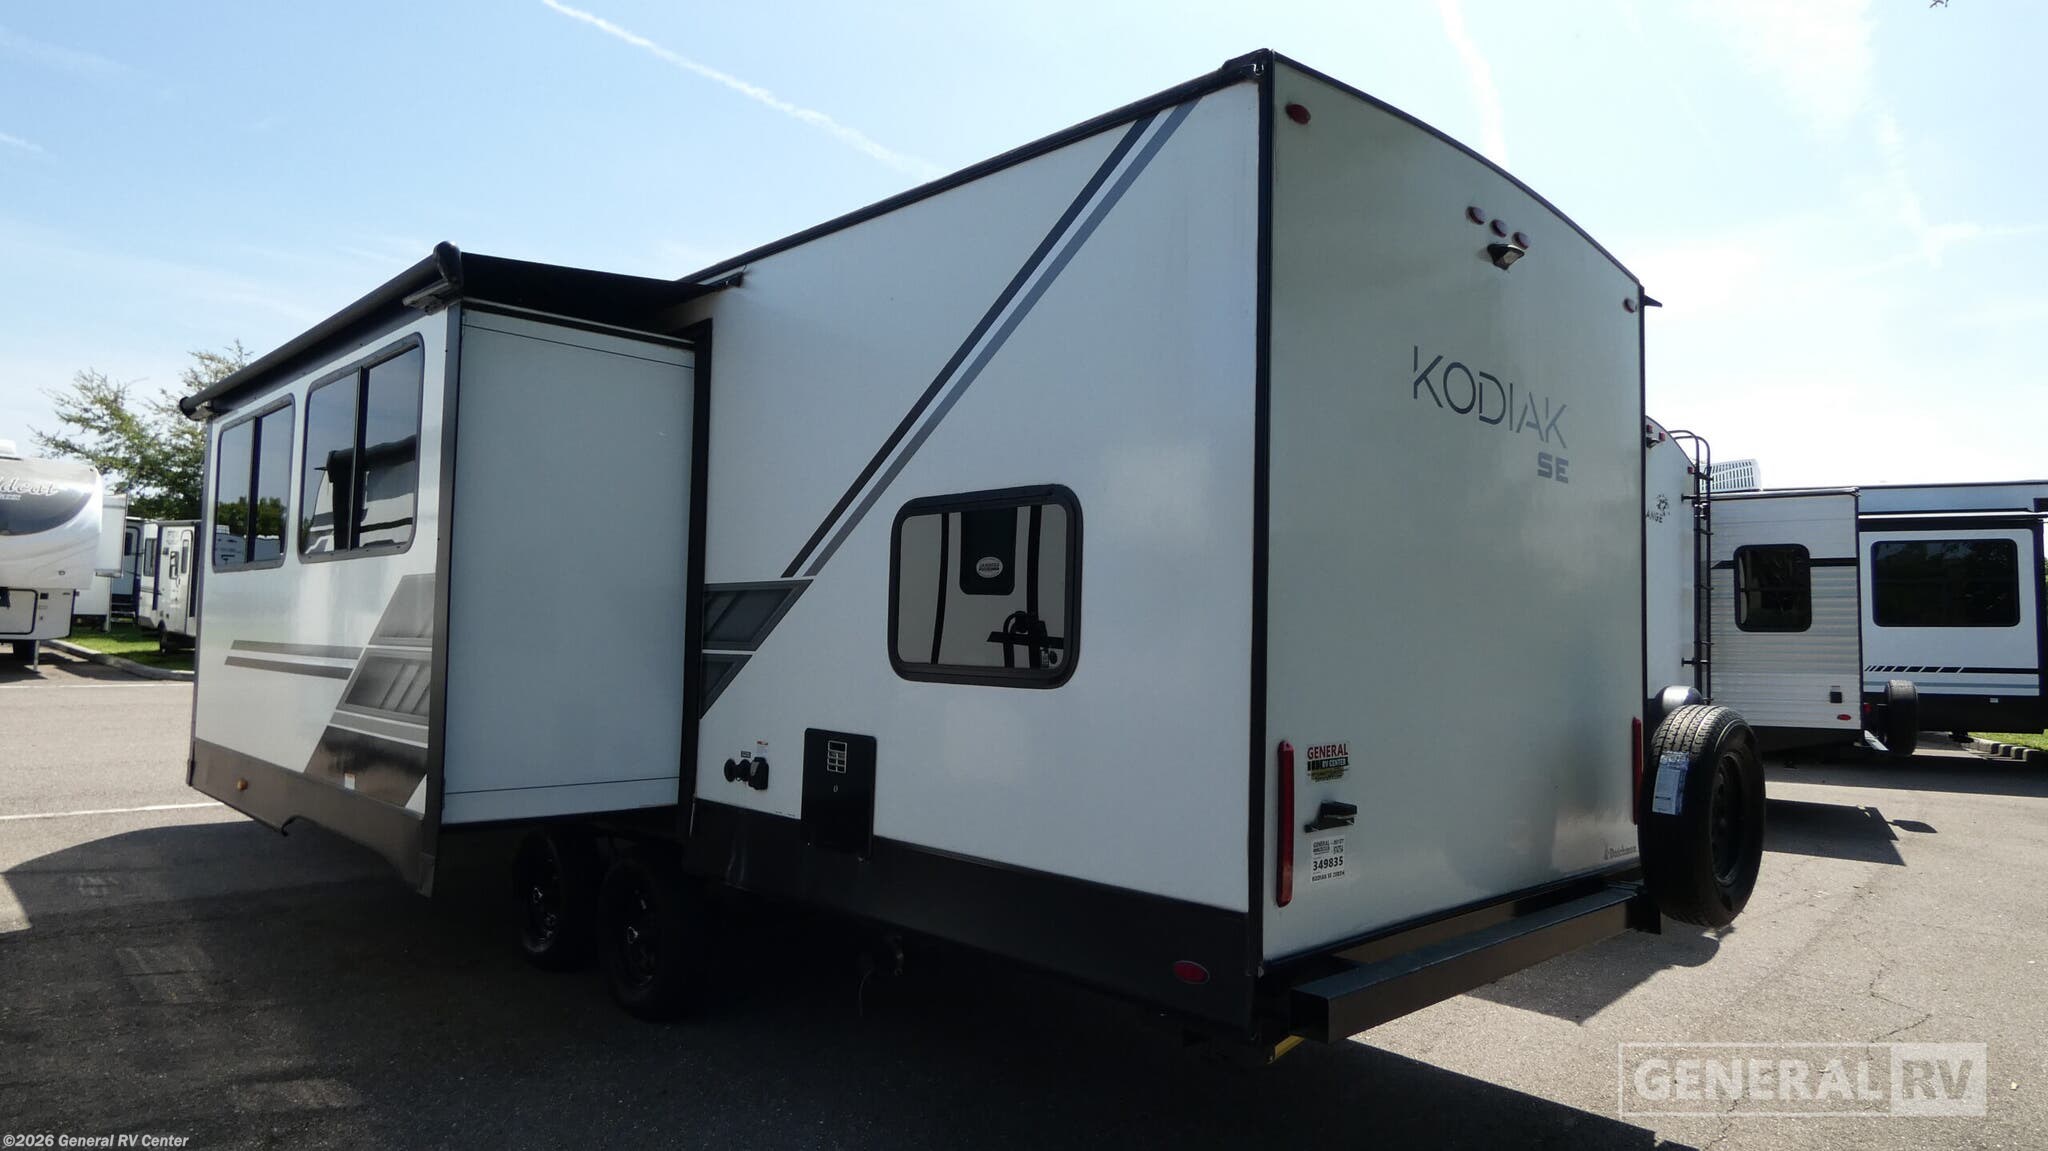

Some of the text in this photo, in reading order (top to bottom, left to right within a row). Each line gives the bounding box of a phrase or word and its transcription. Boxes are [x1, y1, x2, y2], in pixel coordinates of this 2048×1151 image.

[1413, 345, 1567, 449] KODIAK
[1537, 451, 1569, 484] SE
[1307, 743, 1349, 760] GENERAL
[1313, 856, 1343, 871] 349835
